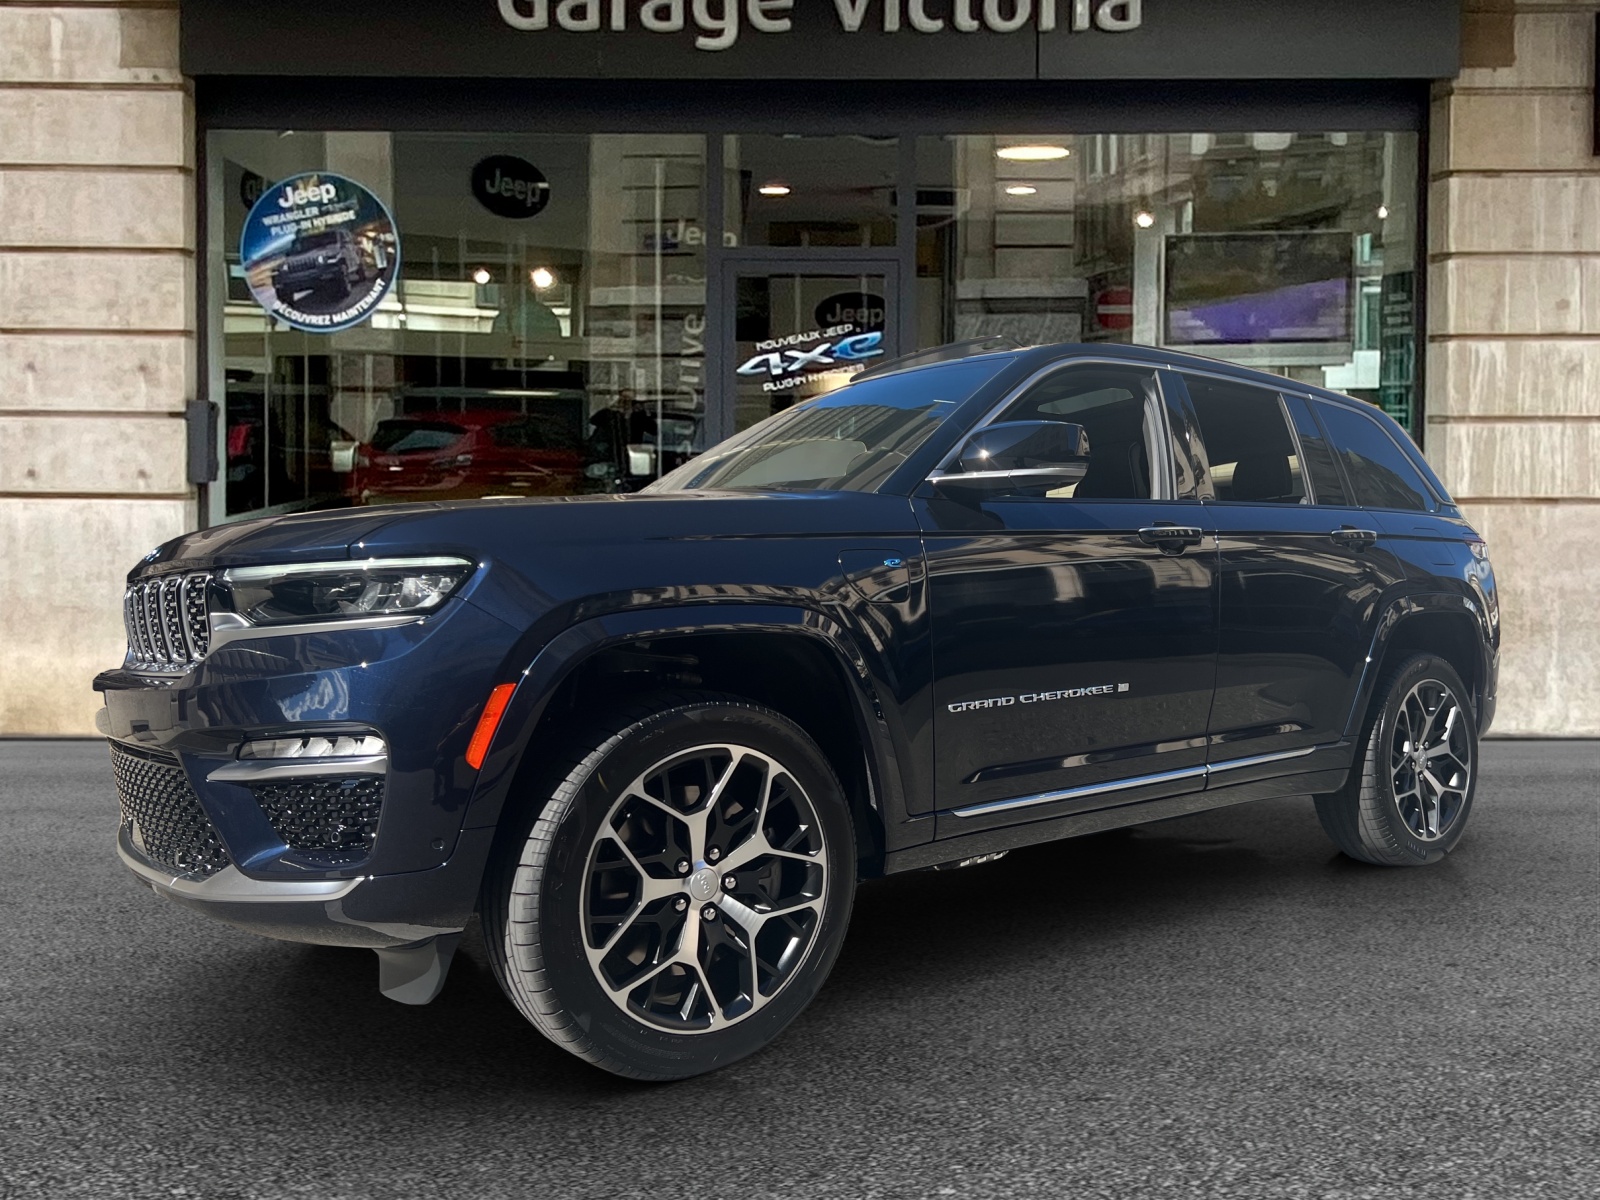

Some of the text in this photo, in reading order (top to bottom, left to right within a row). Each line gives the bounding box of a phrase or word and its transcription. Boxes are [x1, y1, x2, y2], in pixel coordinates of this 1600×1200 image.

[498, 0, 1142, 50] Garage Victoria
[278, 182, 336, 208] Jeep
[485, 168, 541, 207] Jeep
[262, 206, 320, 227] WRANGLER
[272, 278, 386, 325] DÉCOUVREZ MAINTENANT
[826, 303, 884, 326] Jeep
[756, 324, 853, 351] NOUVEAUX JEEP
[948, 684, 1114, 713] GRAND CHEROKEE
